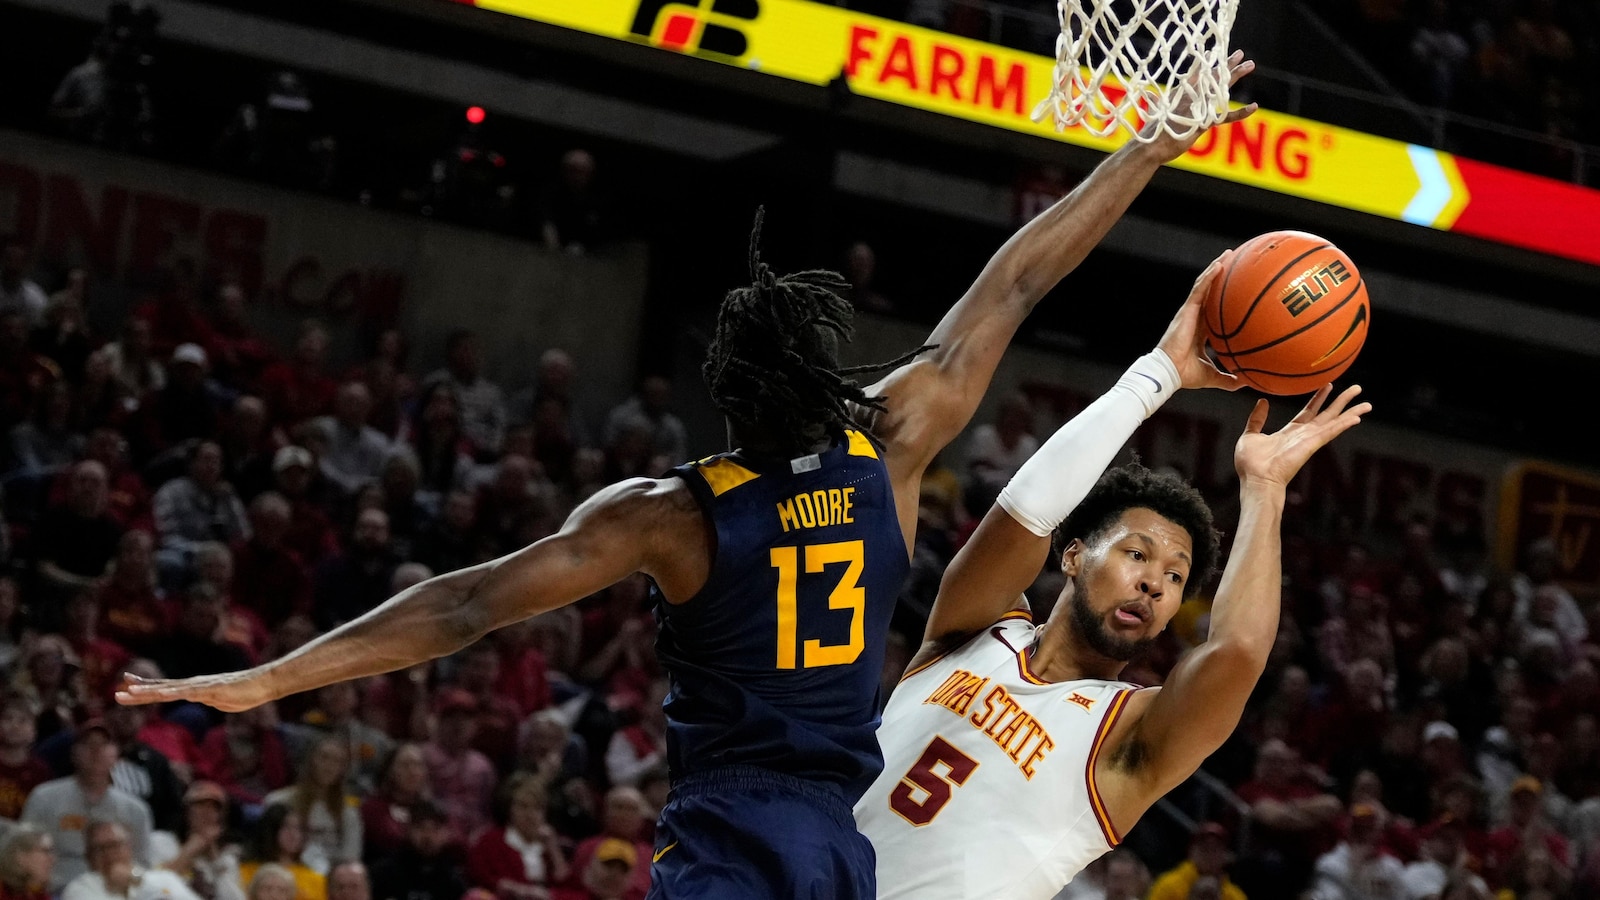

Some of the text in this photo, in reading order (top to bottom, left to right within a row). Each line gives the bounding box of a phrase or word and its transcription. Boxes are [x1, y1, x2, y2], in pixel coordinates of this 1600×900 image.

[846, 25, 1027, 116] FARM
[776, 486, 856, 533] MOORE
[769, 539, 866, 670] 13
[968, 683, 1056, 782] STATE
[888, 733, 981, 827] 5
